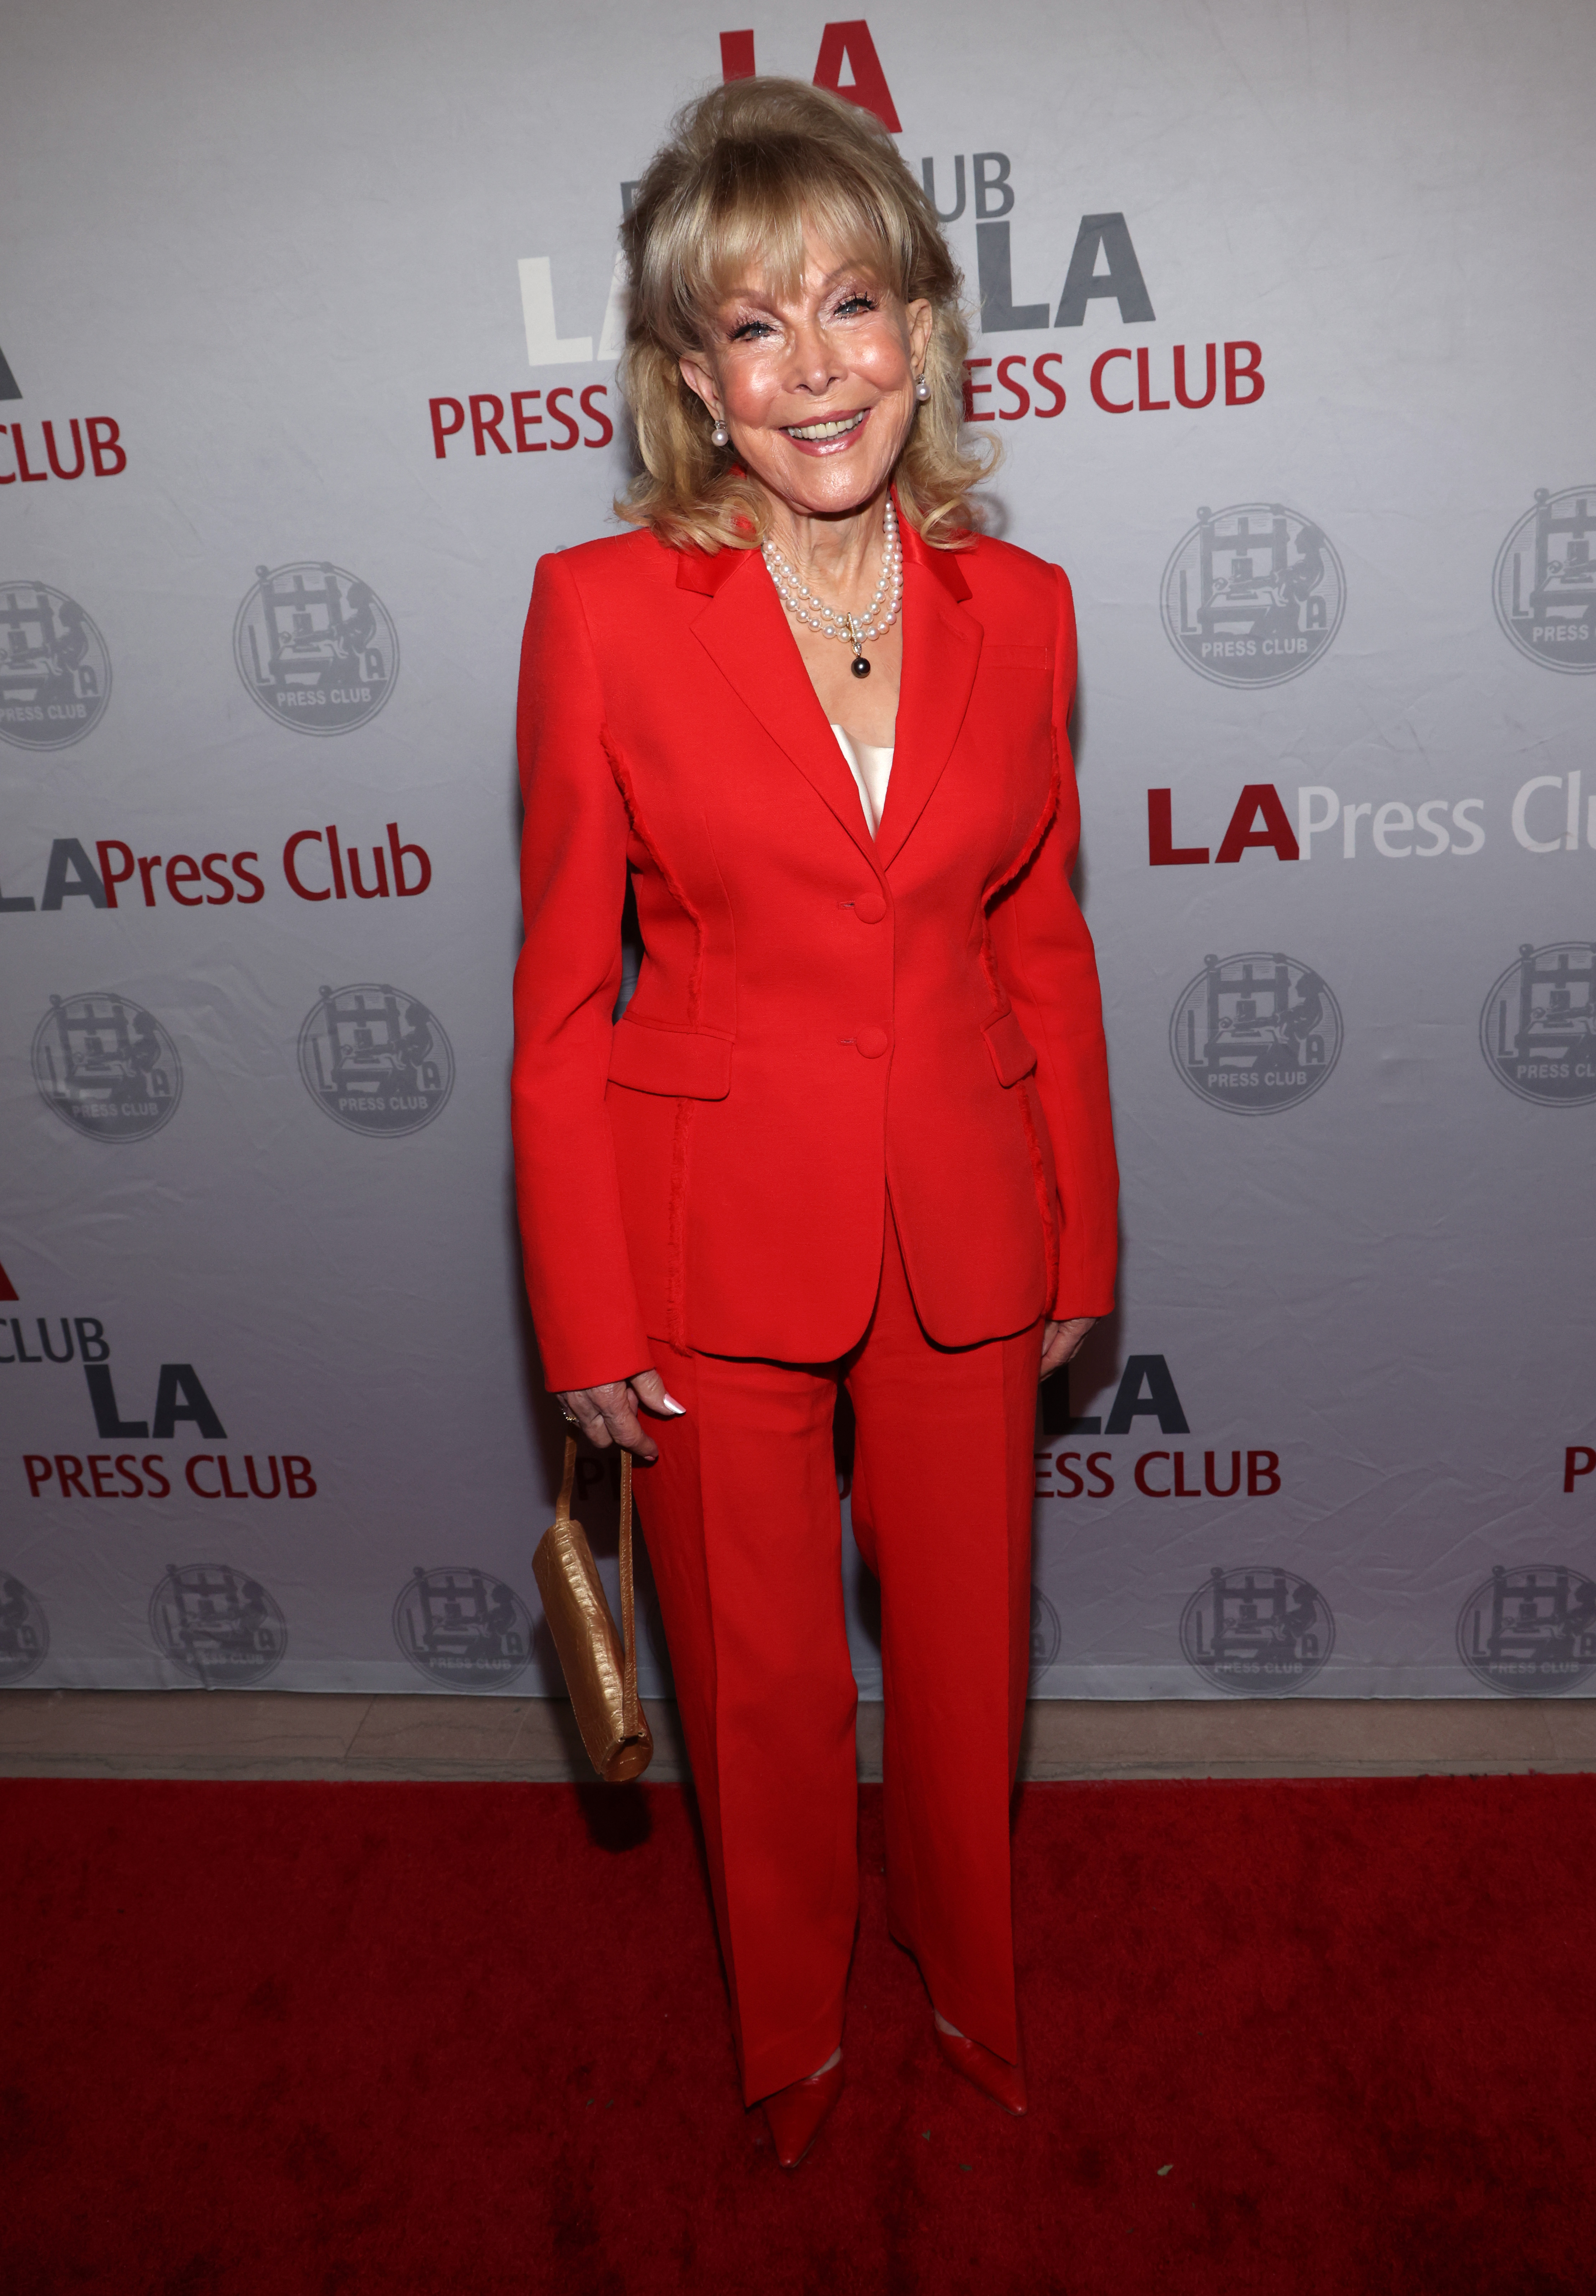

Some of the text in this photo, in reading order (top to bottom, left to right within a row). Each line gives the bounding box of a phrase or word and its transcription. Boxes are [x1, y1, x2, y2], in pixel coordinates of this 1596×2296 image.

[976, 212, 1156, 333] LA
[1090, 340, 1265, 414] CLUB
[429, 384, 613, 460] PRESS
[1533, 624, 1589, 642] PRESS
[1201, 638, 1308, 658] PRESS CLUB
[277, 688, 372, 707] PRESS CLUB
[0, 704, 87, 722] RESS CLUB
[1511, 770, 1596, 853] Cl
[283, 822, 432, 902] Club
[1207, 1071, 1307, 1088] PRESS CLUB
[1517, 1063, 1570, 1079] PRESS
[72, 1103, 159, 1118] PRESS CLUB
[338, 1096, 429, 1111] PRESS CLUB
[83, 1363, 228, 1439] LA
[1041, 1354, 1191, 1435] LA
[22, 1454, 318, 1499] PRESS CLUB
[1134, 1450, 1281, 1497] CLUB
[429, 1657, 512, 1670] PRESS CLUB
[1264, 1662, 1303, 1674] CLUB
[1541, 1661, 1579, 1673] CLUB
